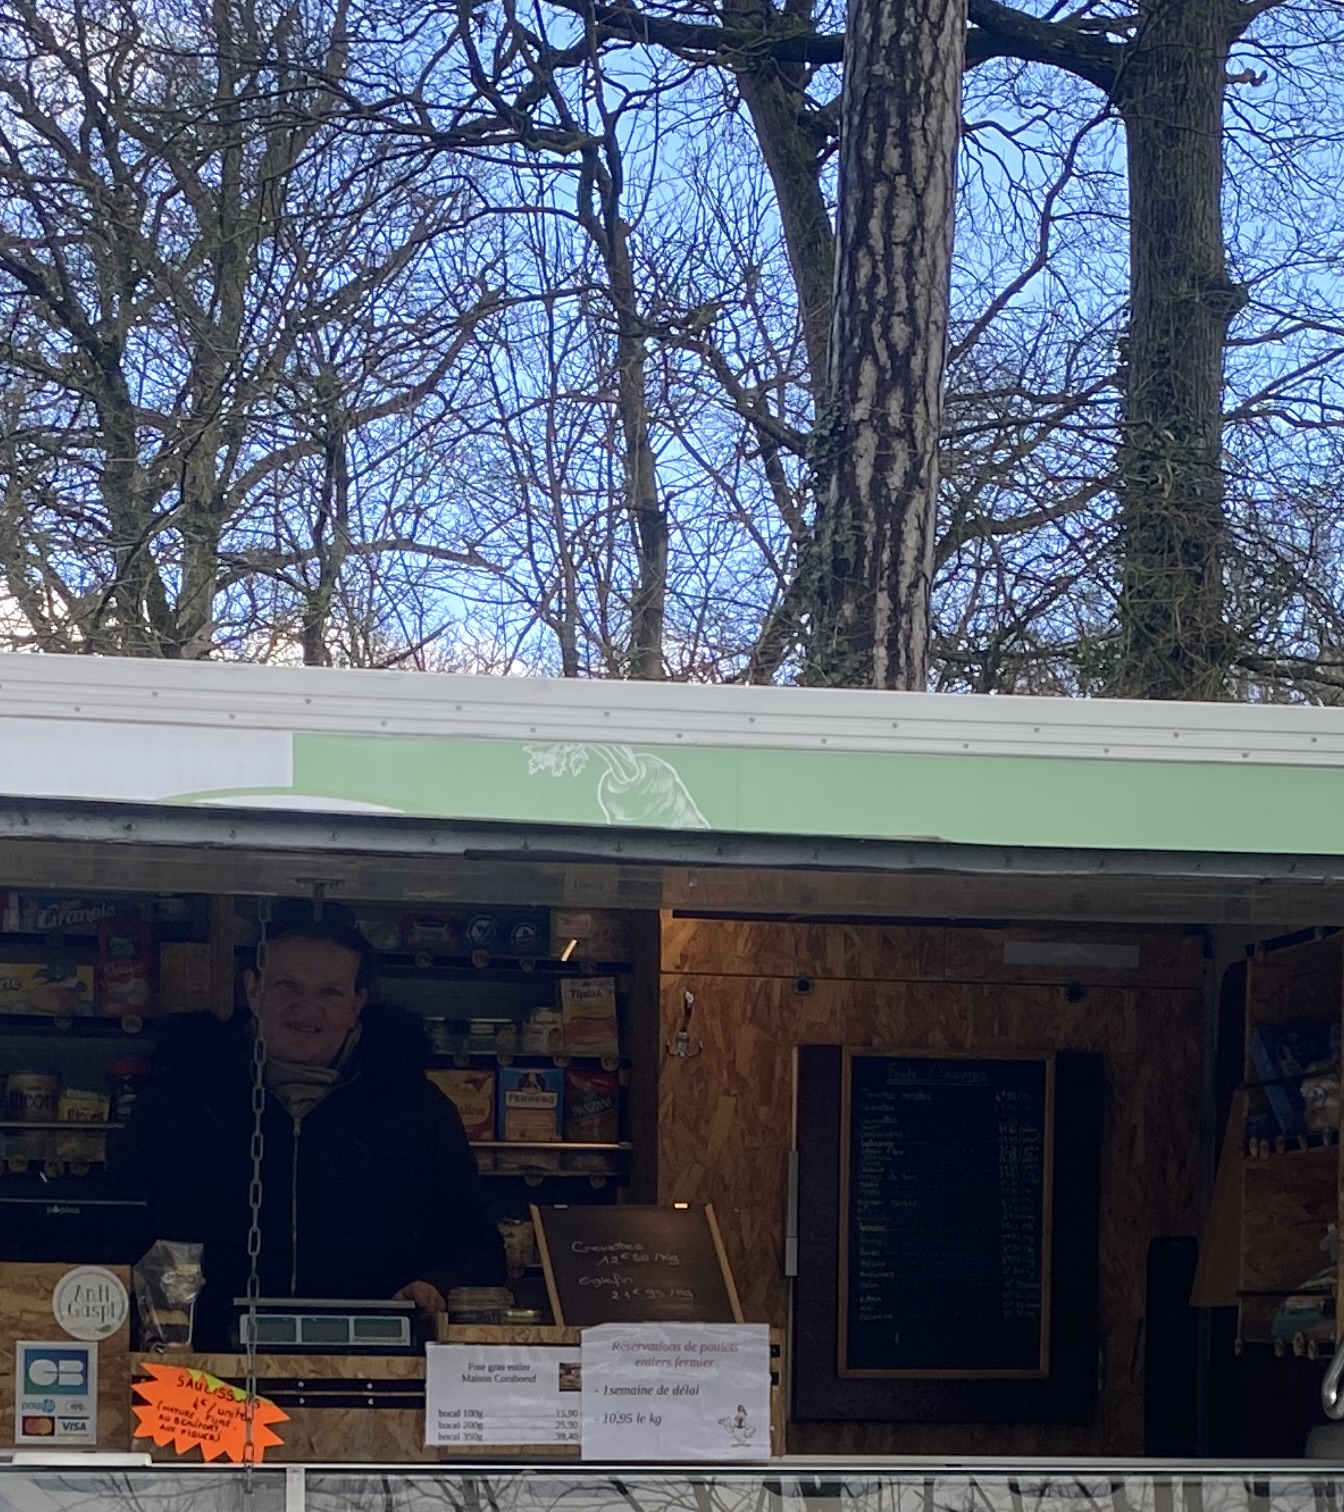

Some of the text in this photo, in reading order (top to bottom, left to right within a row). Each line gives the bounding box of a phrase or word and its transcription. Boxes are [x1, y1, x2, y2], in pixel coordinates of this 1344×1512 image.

[38, 901, 116, 929] Granola
[684, 1341, 698, 1352] de
[699, 1341, 739, 1354] poulets
[507, 1362, 531, 1371] entier
[634, 1356, 715, 1369] entiers fermier
[461, 1374, 492, 1383] Maison
[656, 1385, 670, 1396] de
[672, 1384, 700, 1396] délai
[438, 1408, 461, 1418] bocal
[636, 1412, 646, 1424] le
[649, 1412, 662, 1426] kg
[62, 1421, 87, 1431] VISA
[438, 1421, 461, 1430] bocal
[438, 1432, 461, 1441] bocal
